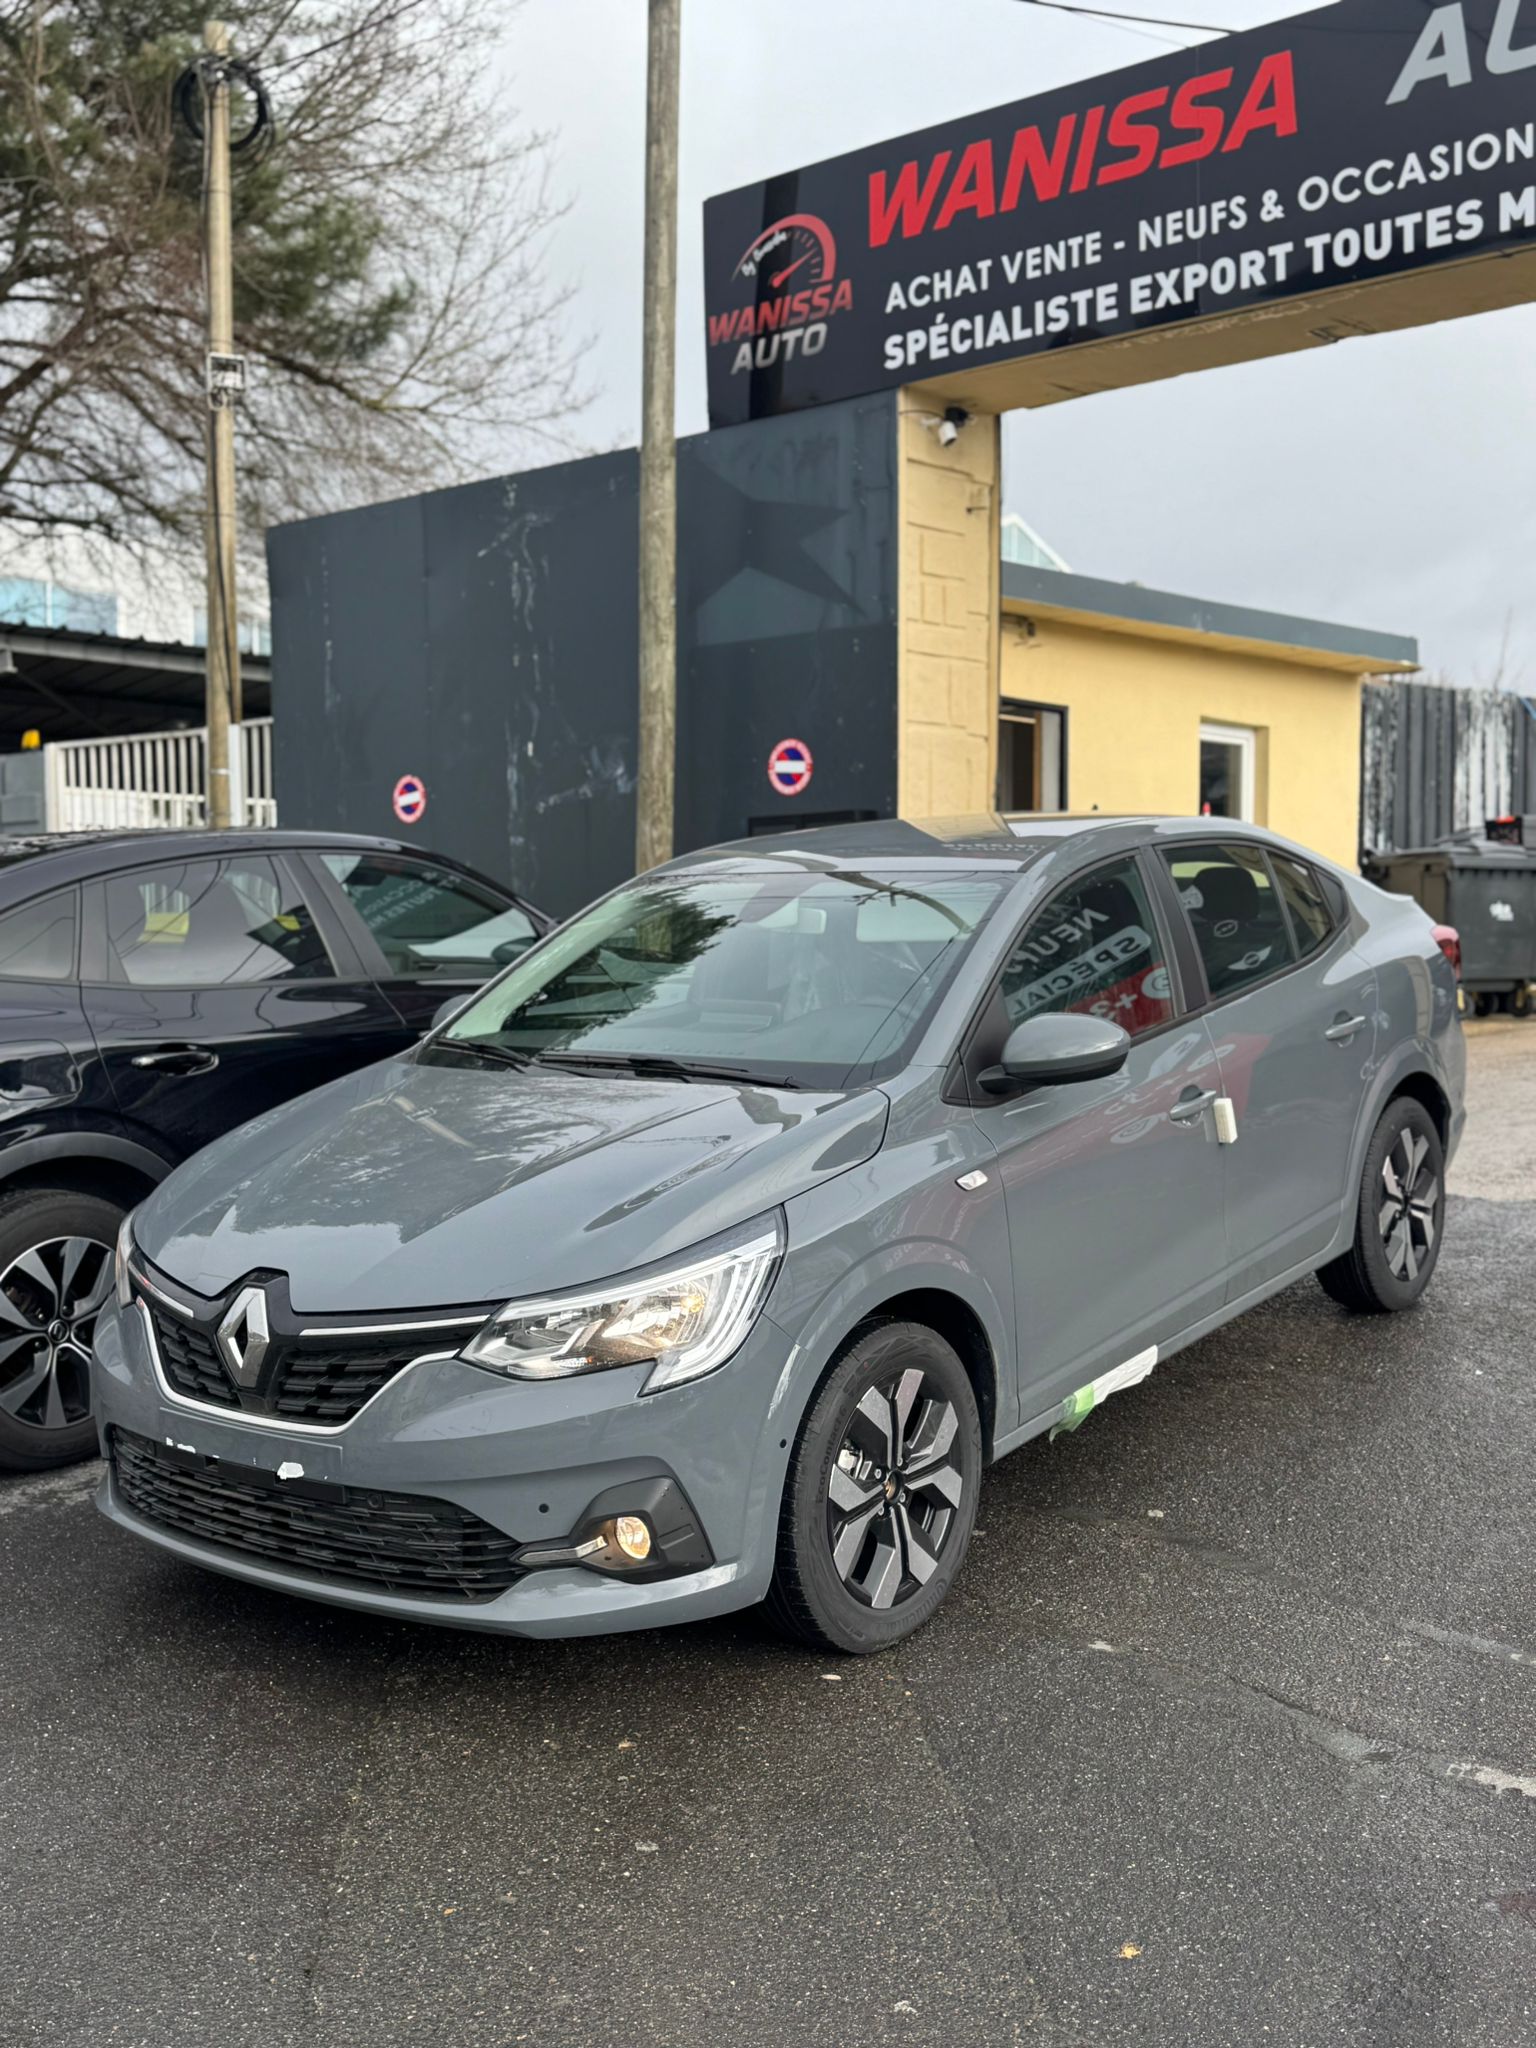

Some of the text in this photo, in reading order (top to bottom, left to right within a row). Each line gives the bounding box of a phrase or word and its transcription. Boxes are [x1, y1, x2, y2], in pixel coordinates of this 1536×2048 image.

[868, 49, 1298, 249] WANISSA
[885, 258, 993, 314] ACHAT
[1001, 230, 1103, 284] VENTE
[1138, 195, 1248, 253] NEUFS
[1259, 189, 1286, 223] &
[1297, 122, 1535, 212] OCCASION
[708, 278, 853, 347] WANISSA
[730, 321, 828, 376] AUTO
[883, 282, 1119, 371] SPÉCIALISTE
[1129, 241, 1294, 316] EXPORT
[1304, 198, 1485, 275] TOUTES
